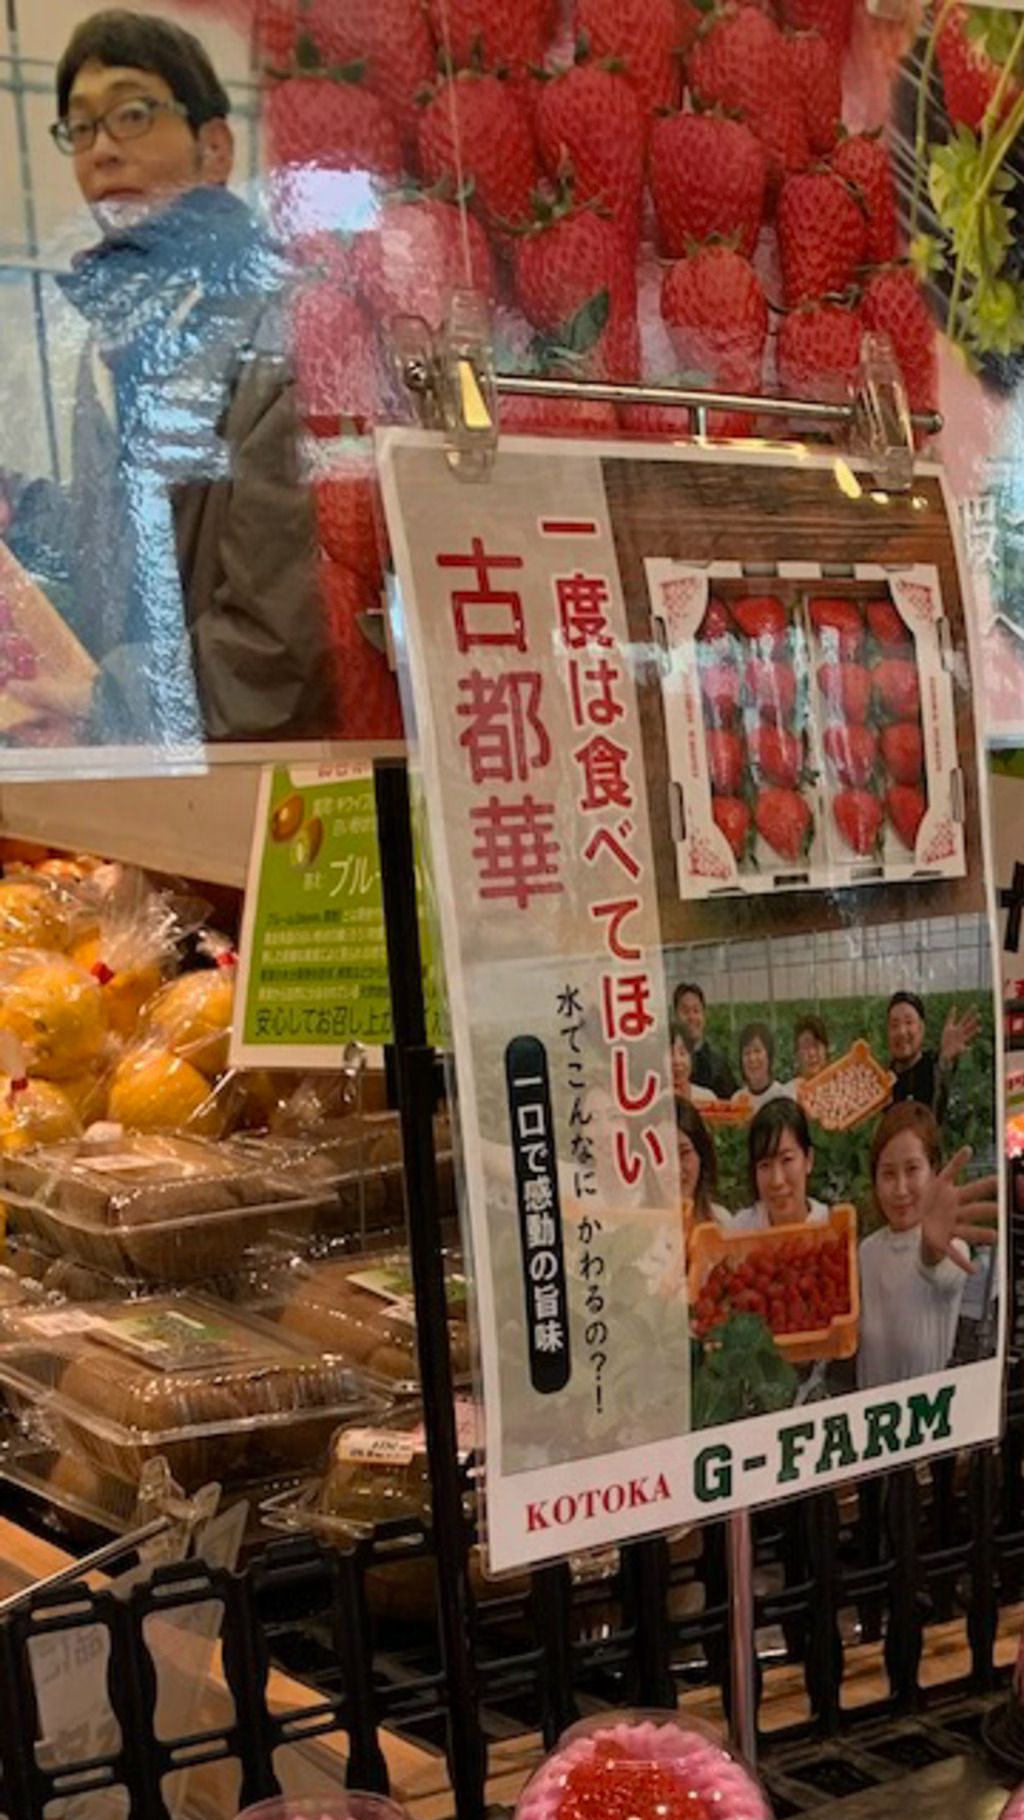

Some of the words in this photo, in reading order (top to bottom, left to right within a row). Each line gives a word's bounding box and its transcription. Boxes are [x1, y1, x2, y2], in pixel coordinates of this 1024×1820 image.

[437, 537, 564, 910] 古都華
[538, 517, 667, 1188] 一度は食べてほしい
[512, 1076, 564, 1352] 一口で感動の旨味
[524, 1472, 671, 1533] KOTOKA
[693, 1384, 956, 1502] G-FARM
